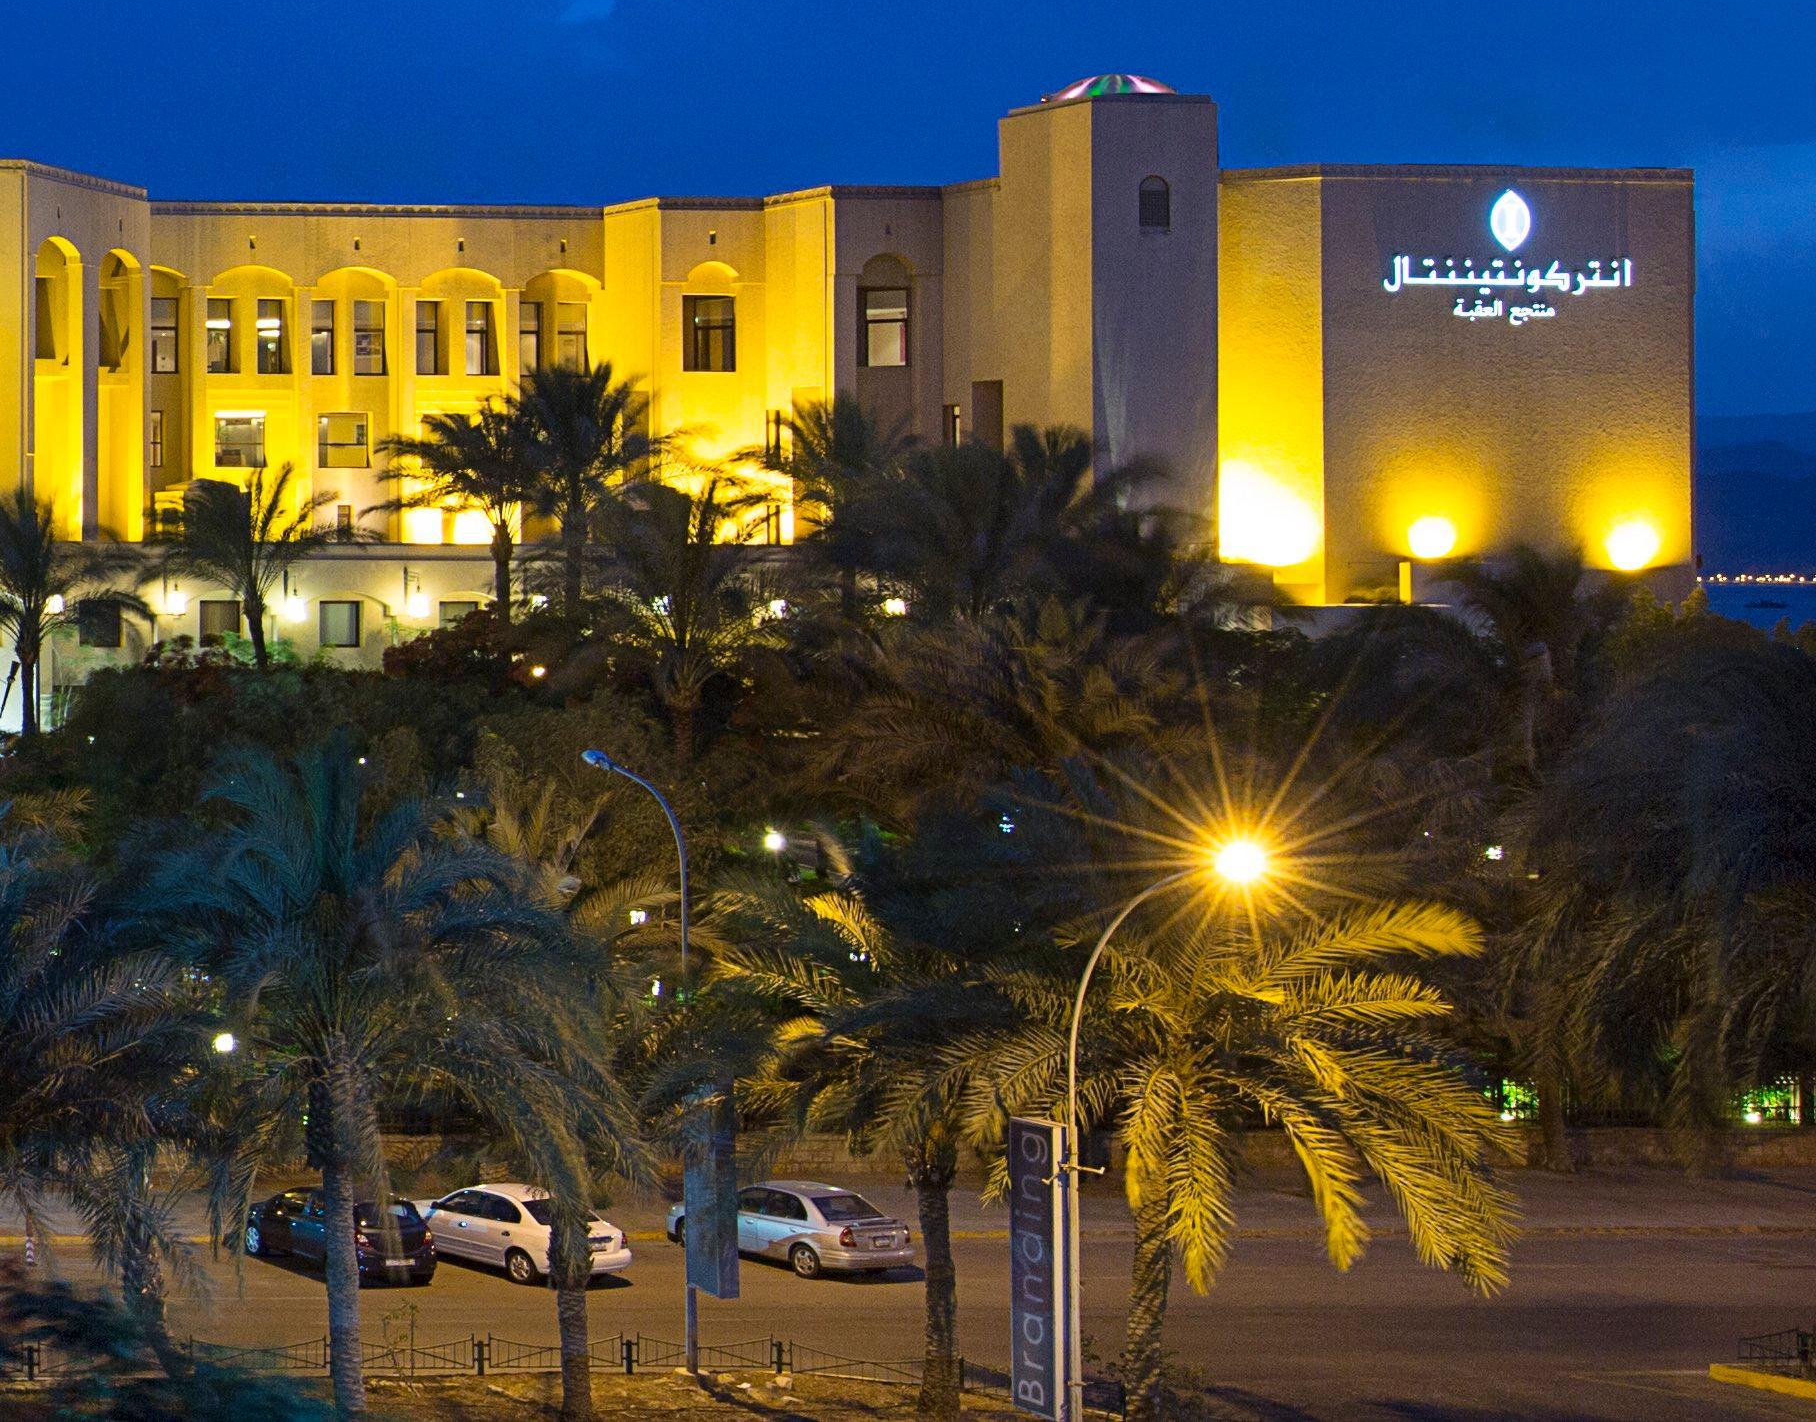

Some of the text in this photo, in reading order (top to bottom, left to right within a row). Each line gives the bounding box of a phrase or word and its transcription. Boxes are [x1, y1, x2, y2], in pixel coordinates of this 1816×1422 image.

[1453, 297, 1556, 326] منتجع العقبة
[1017, 1130, 1048, 1407] Branding
